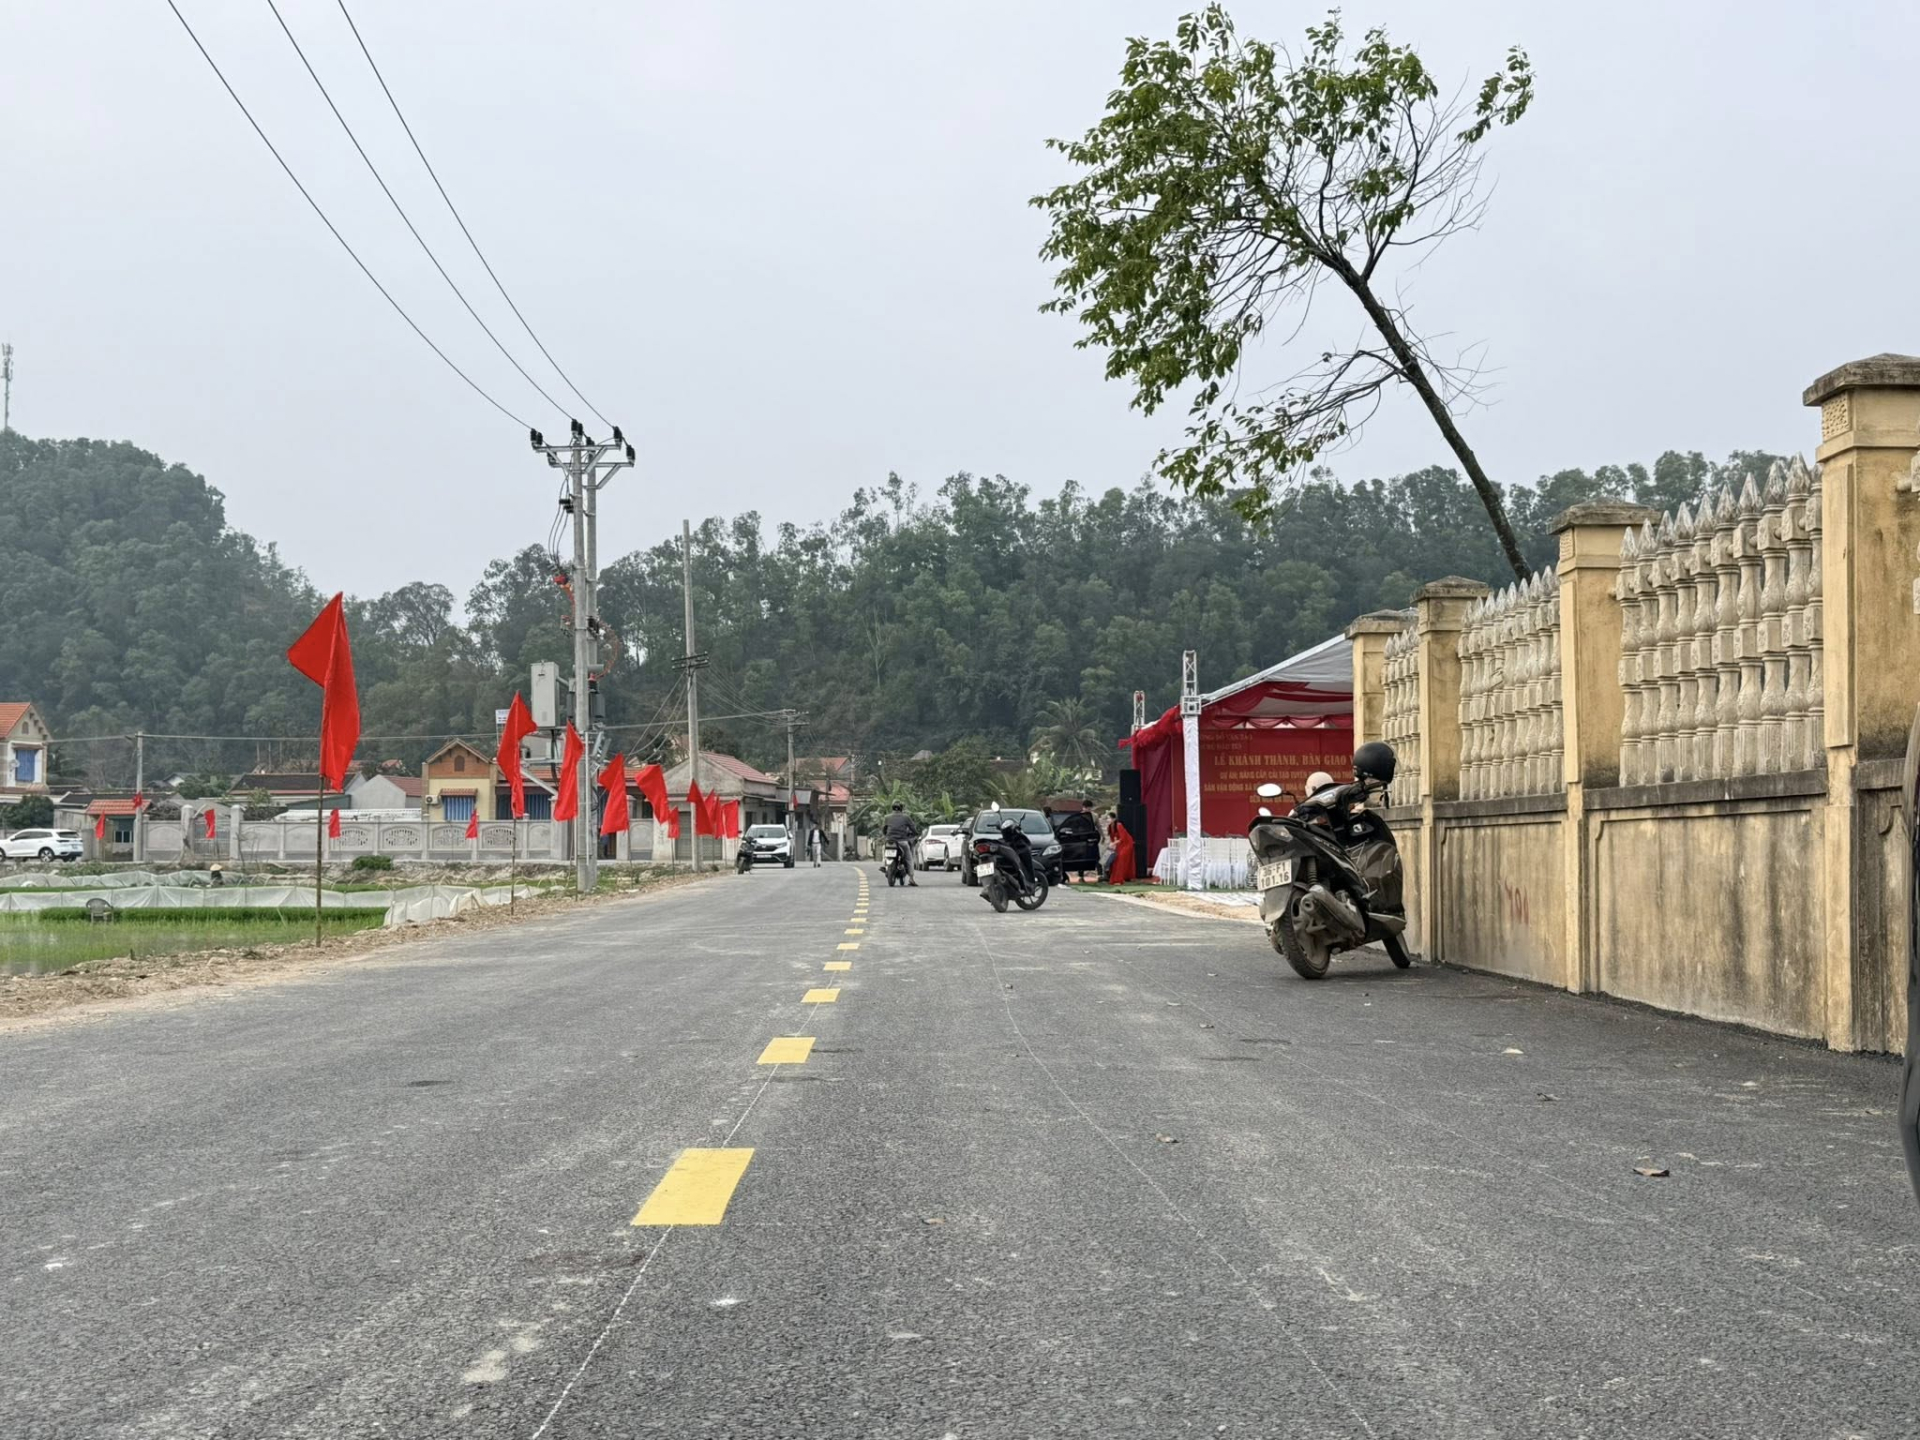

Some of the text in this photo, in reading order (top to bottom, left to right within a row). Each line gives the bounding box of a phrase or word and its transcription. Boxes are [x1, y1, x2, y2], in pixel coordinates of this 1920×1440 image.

[1228, 753, 1261, 766] KHÁNH
[1264, 753, 1299, 767] THÀNH,
[1302, 752, 1321, 766] BÀN
[1324, 754, 1347, 766] GIAO
[1261, 872, 1289, 887] 101.16
